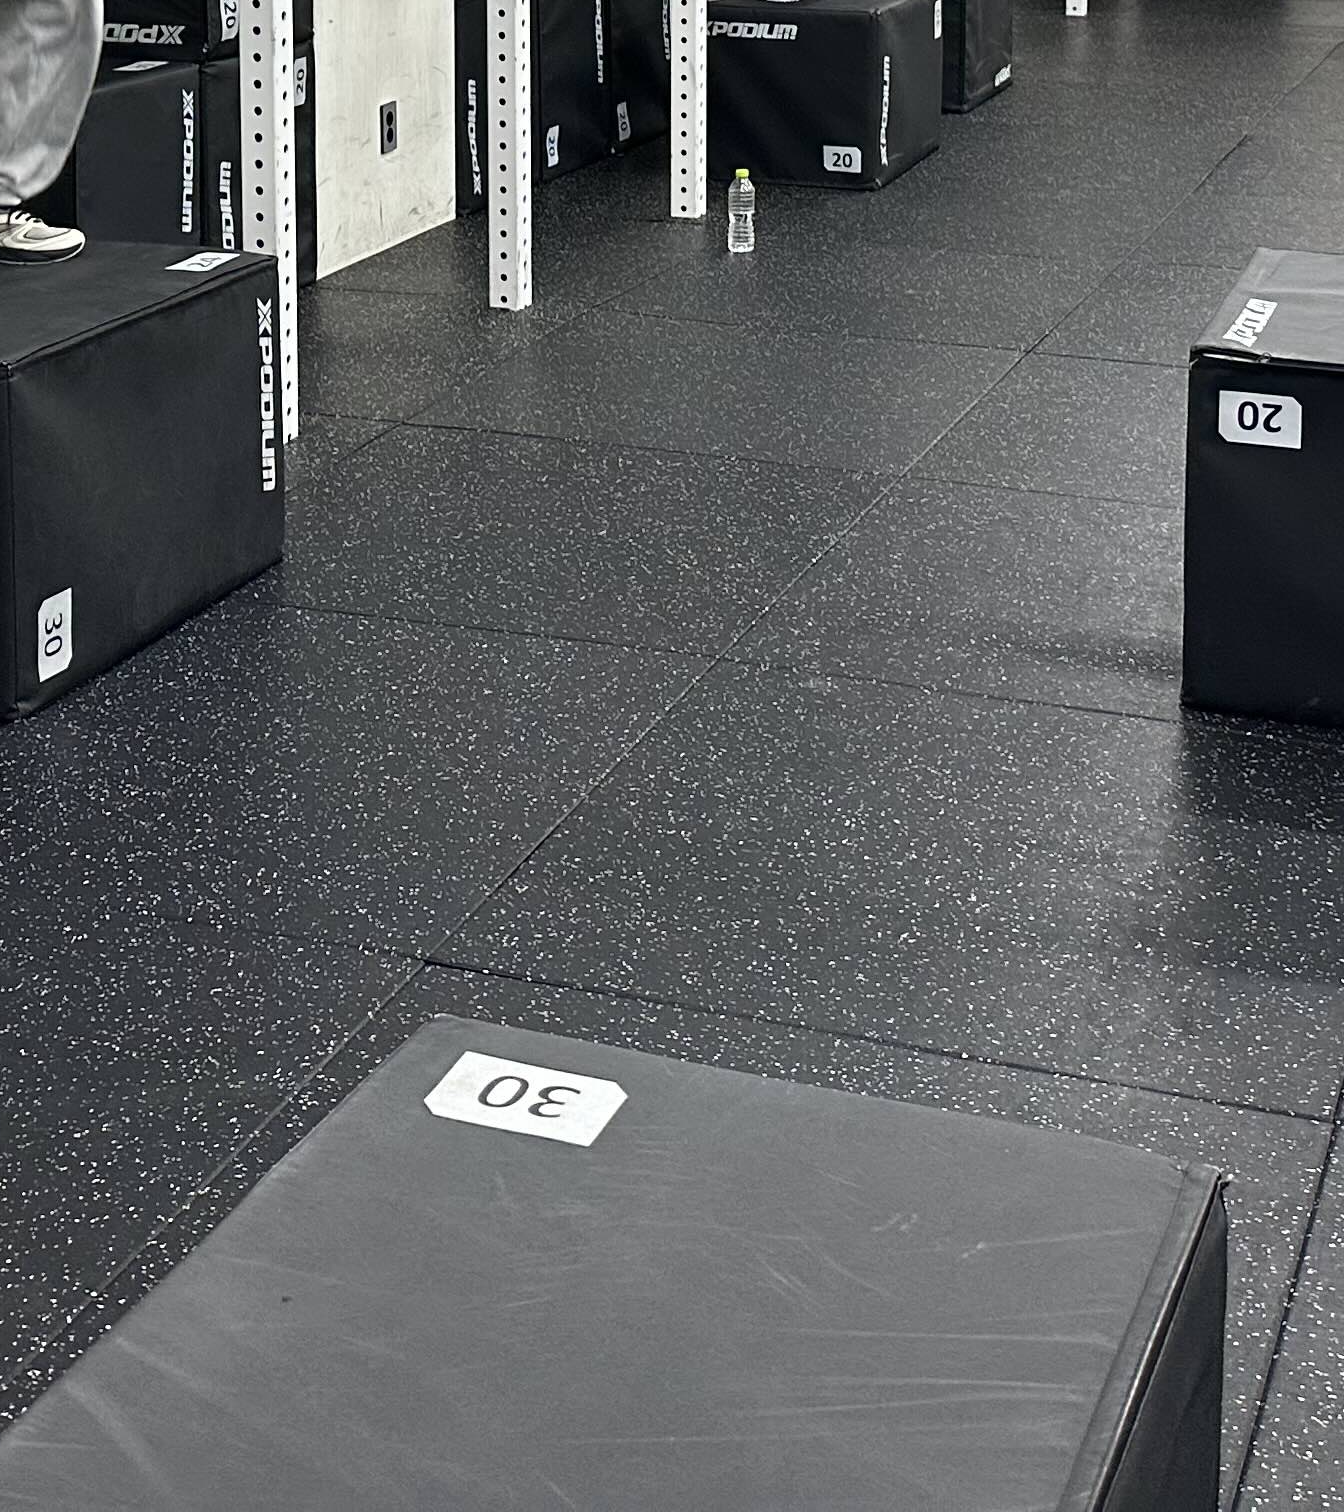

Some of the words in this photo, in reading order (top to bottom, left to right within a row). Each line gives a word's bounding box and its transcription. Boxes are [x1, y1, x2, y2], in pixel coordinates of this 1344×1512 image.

[103, 23, 186, 45] XPOD
[223, 1, 237, 29] 20
[297, 69, 305, 94] 20
[467, 79, 482, 196] XPODIUM
[182, 89, 194, 232] XPODIUM
[832, 152, 853, 169] 20
[219, 161, 235, 250] ODIUM
[256, 297, 276, 492] XPODIUM
[1237, 400, 1283, 433] 20
[44, 612, 63, 657] 30
[478, 1075, 581, 1118] 30
